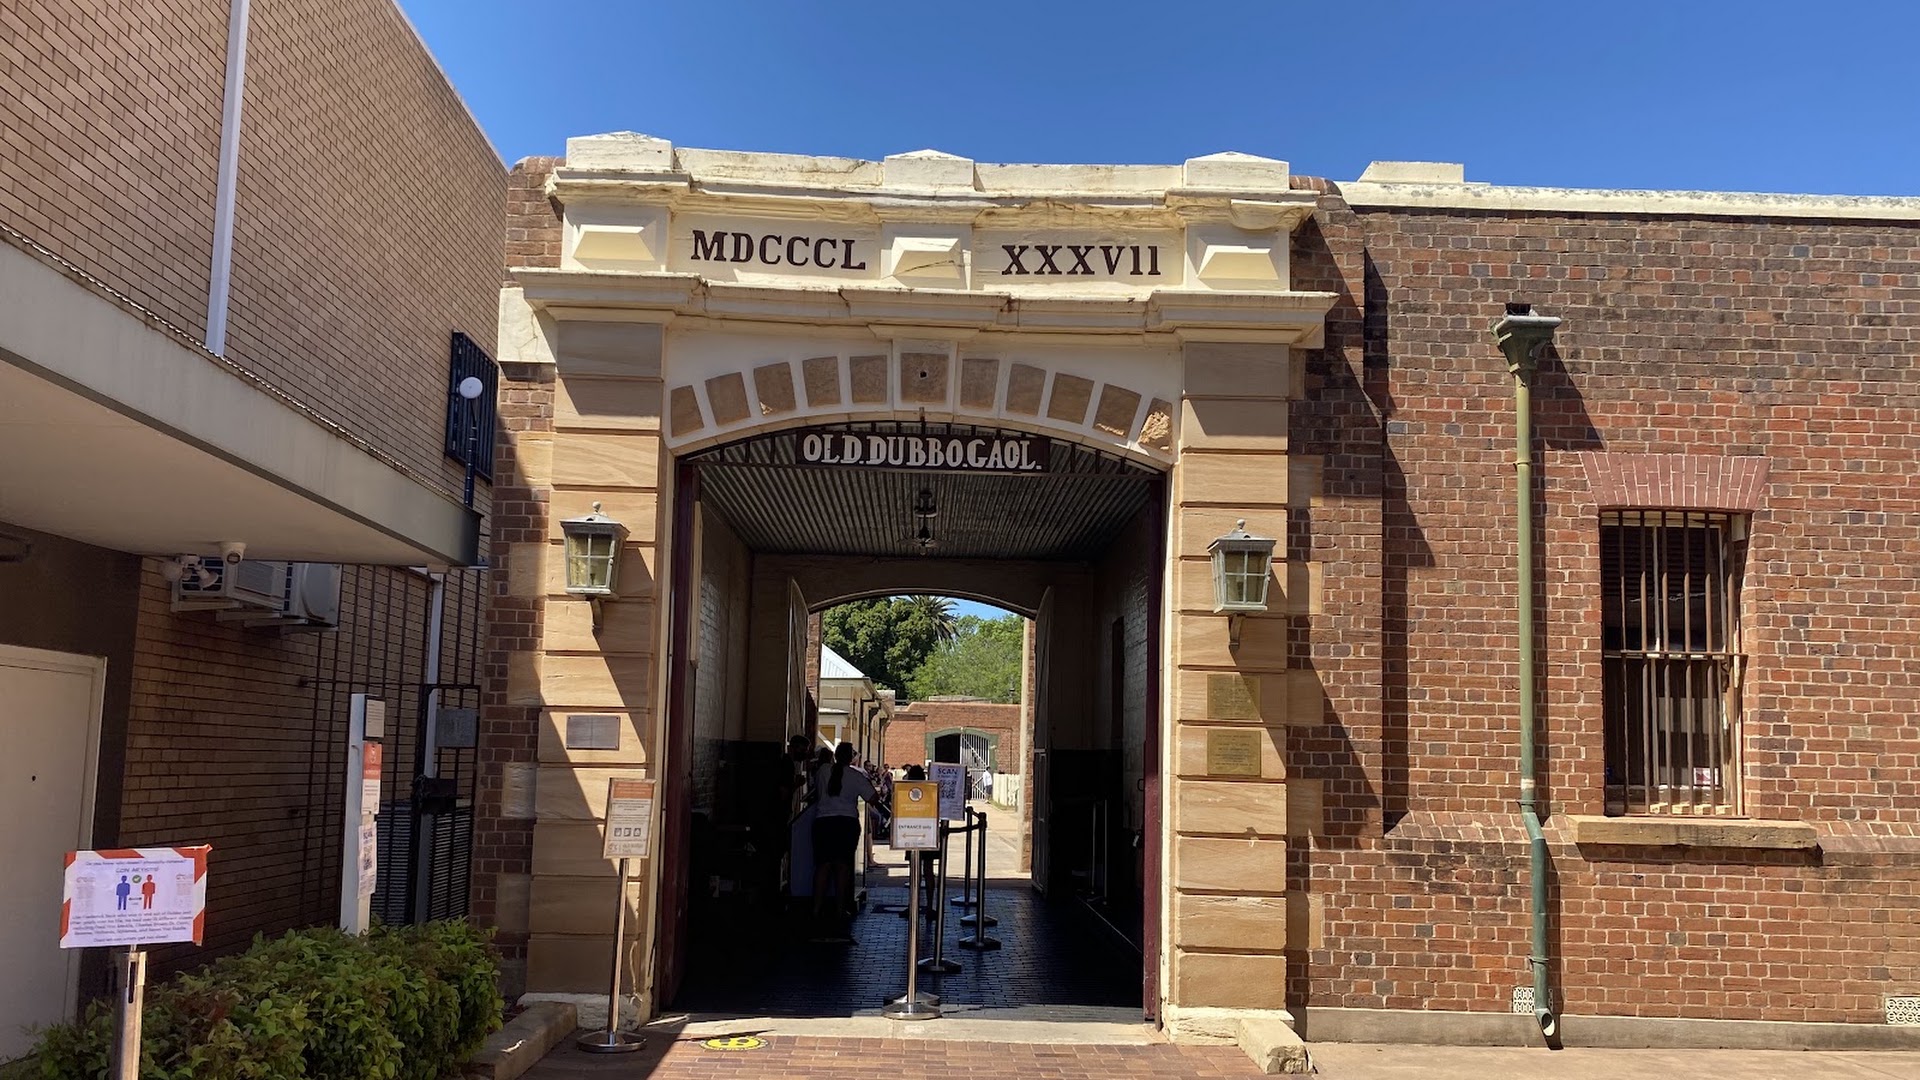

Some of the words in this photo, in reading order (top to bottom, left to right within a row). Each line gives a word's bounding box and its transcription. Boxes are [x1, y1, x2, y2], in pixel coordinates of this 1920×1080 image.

[690, 229, 866, 270] MDCCCL
[1001, 245, 1161, 275] XXXVII
[937, 767, 958, 775] SCAN
